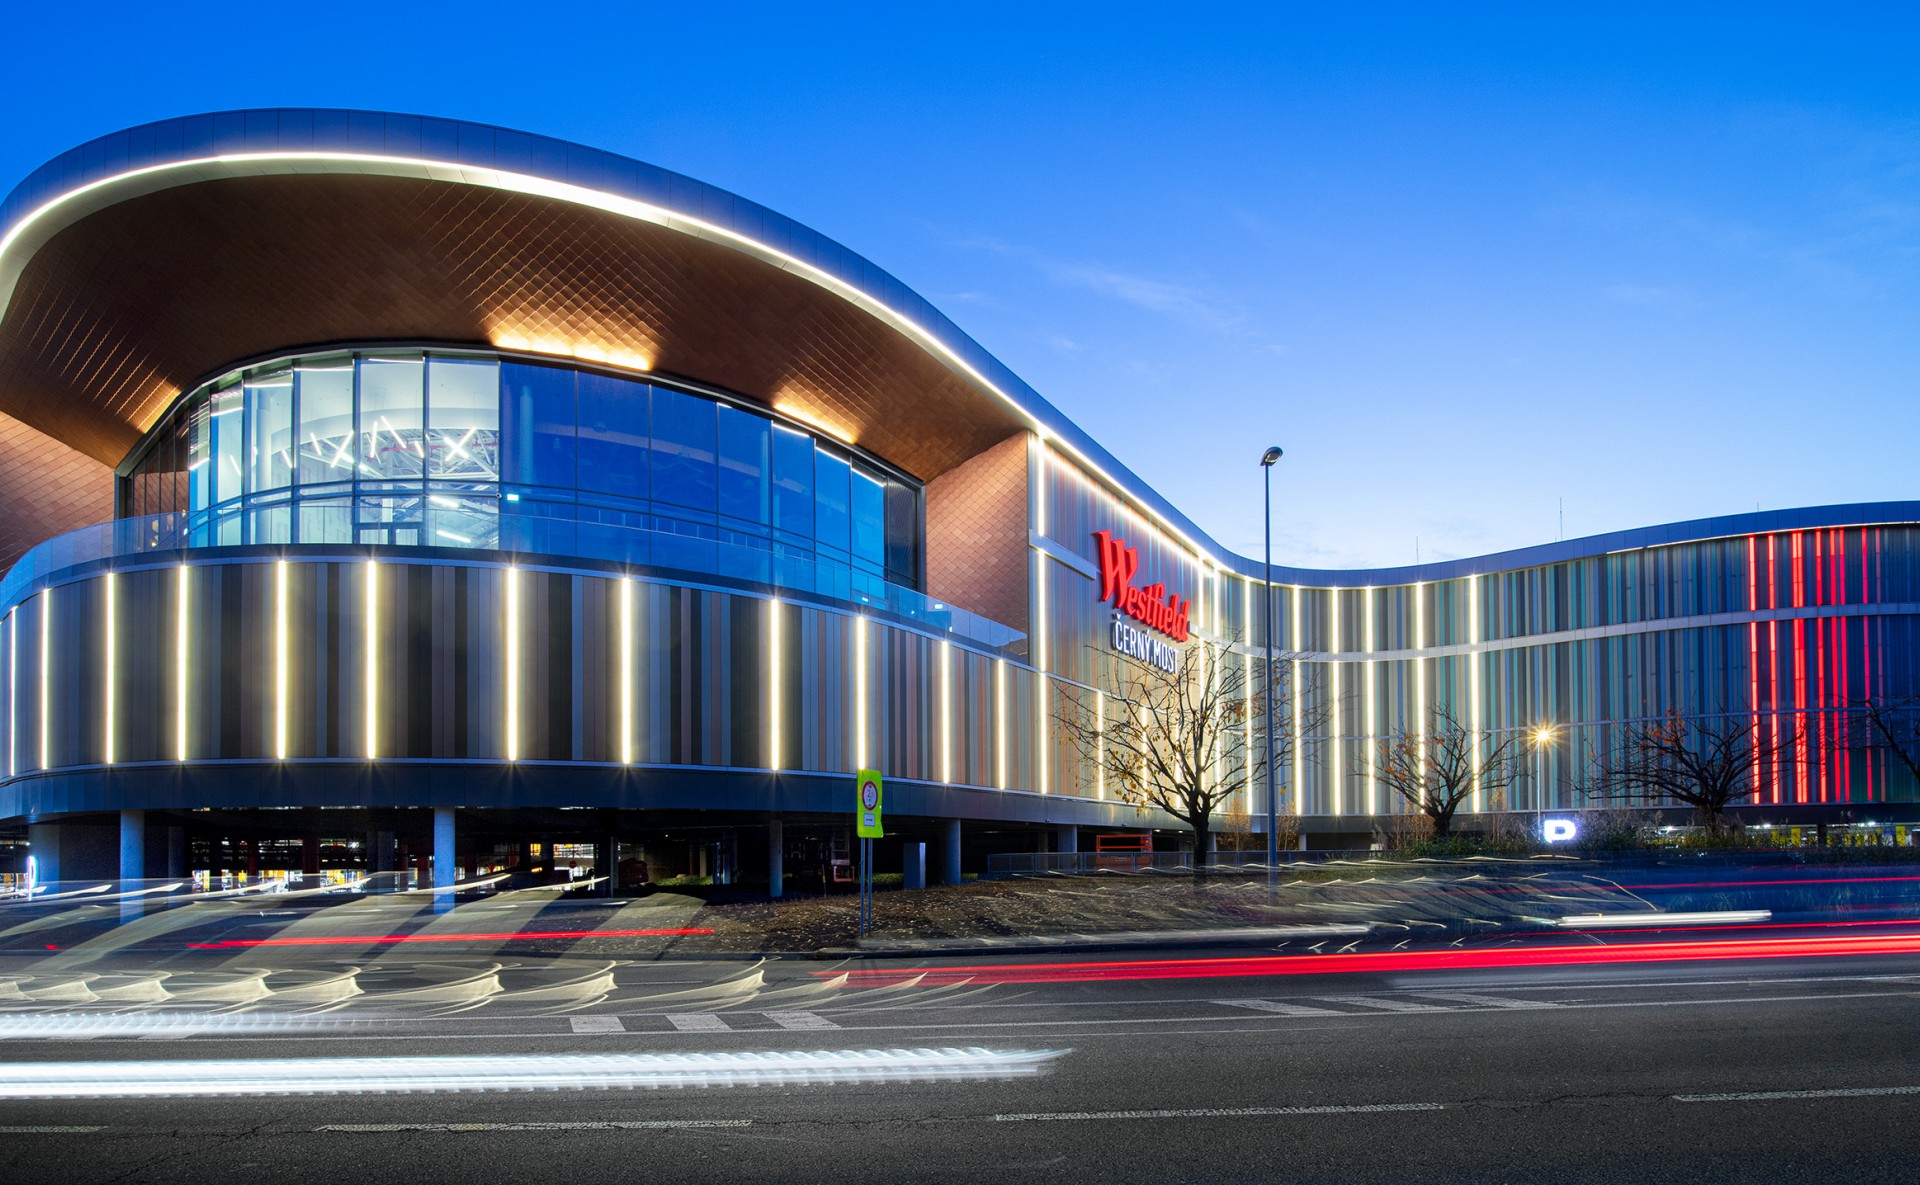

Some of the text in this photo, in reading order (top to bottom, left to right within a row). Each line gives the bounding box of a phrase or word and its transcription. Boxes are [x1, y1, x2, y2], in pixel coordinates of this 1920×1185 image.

[1093, 529, 1190, 643] Westfield
[1113, 613, 1179, 674] ČERNÝ MOST
